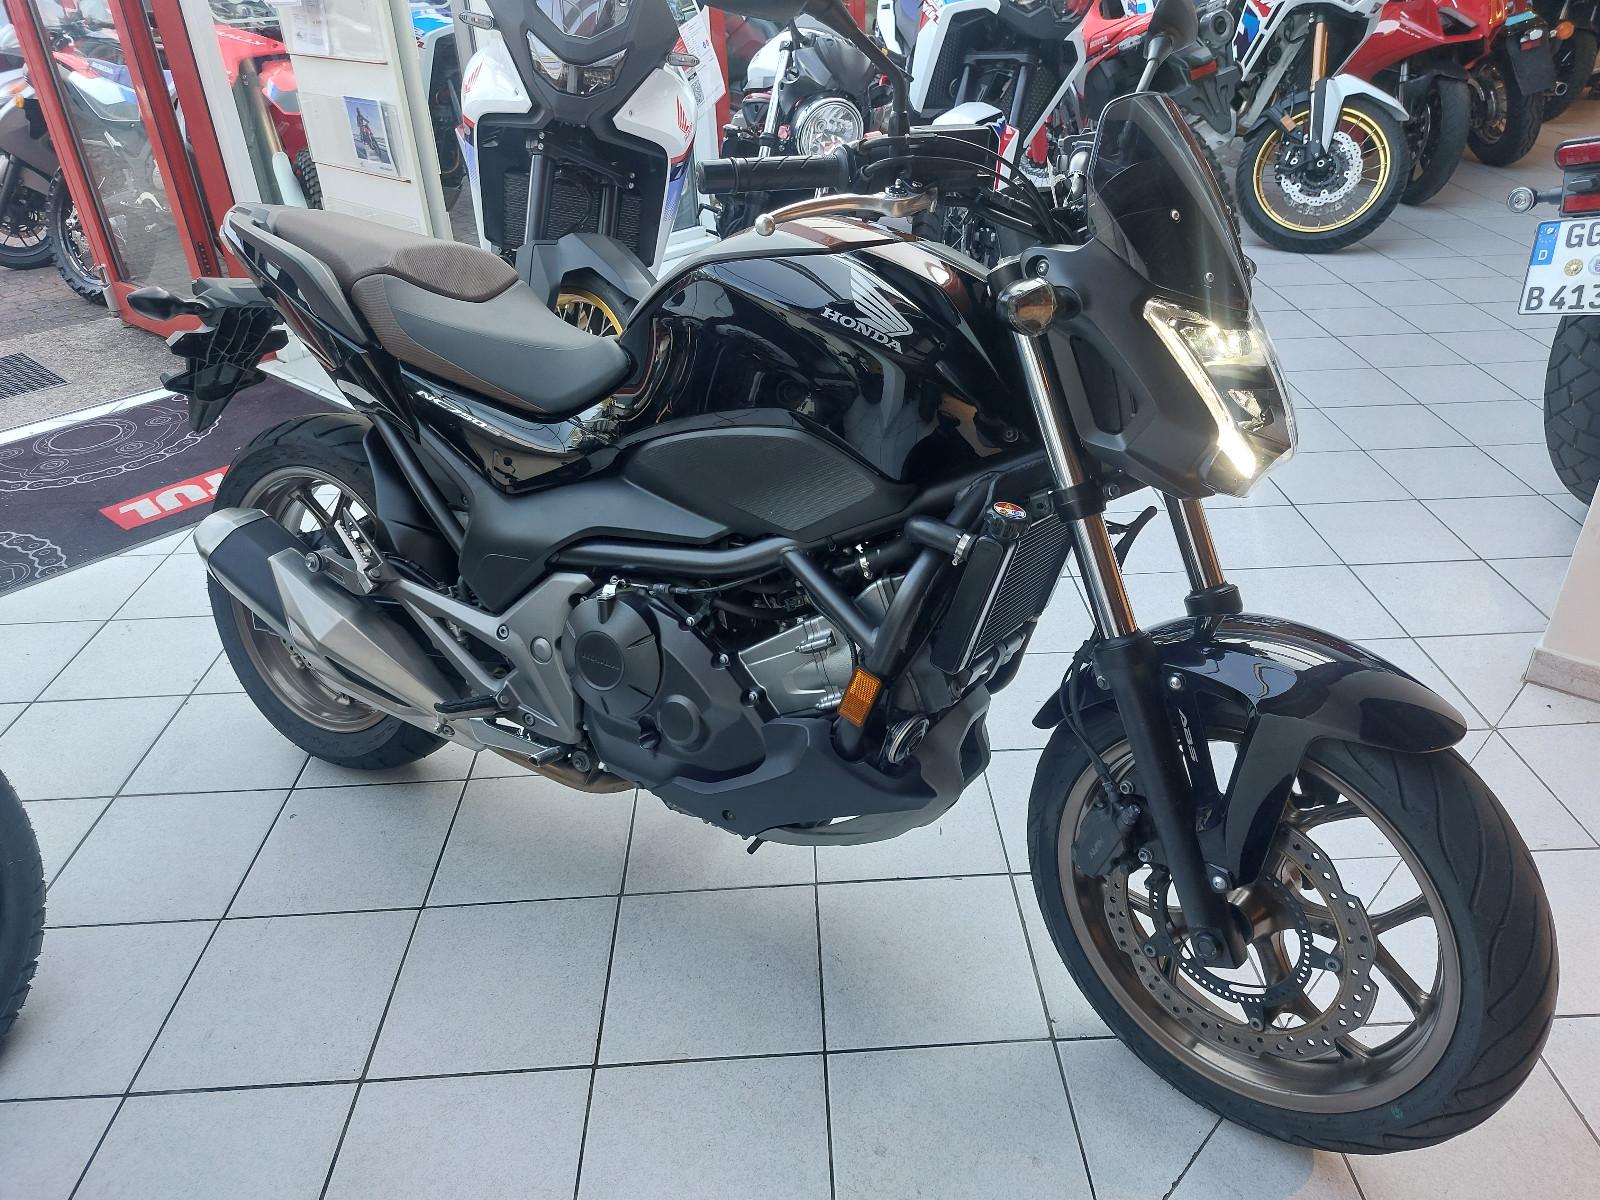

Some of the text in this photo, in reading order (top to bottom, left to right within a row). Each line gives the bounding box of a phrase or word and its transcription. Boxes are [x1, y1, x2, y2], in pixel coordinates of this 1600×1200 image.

[1537, 249, 1548, 261] D
[821, 304, 903, 355] HONDA
[1178, 707, 1199, 763] ABS
